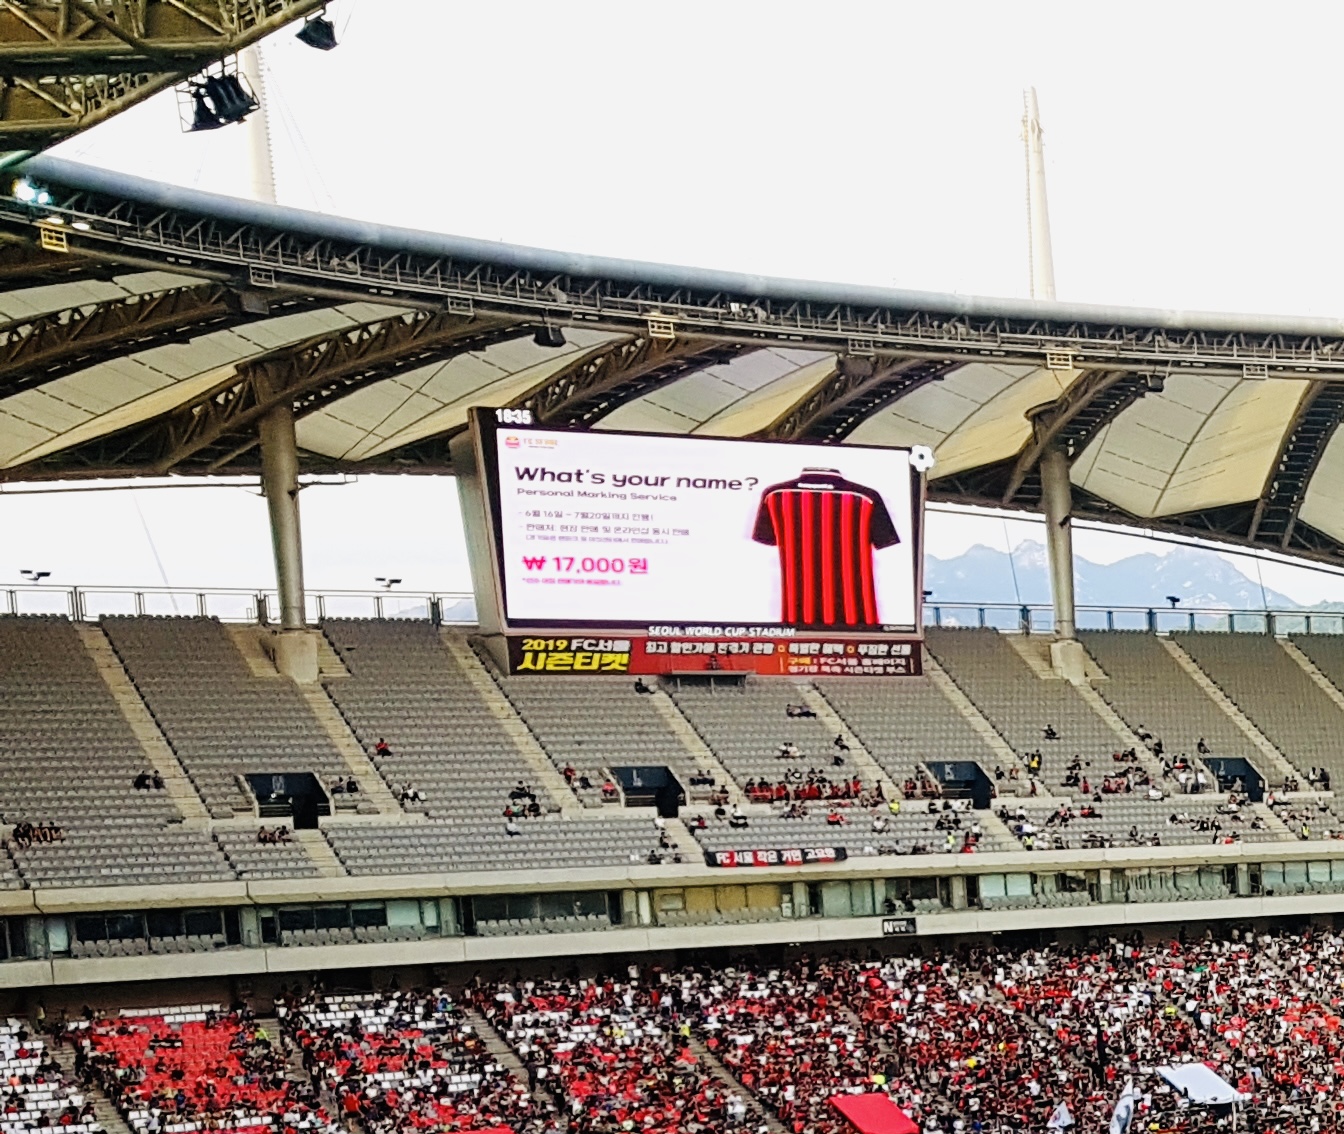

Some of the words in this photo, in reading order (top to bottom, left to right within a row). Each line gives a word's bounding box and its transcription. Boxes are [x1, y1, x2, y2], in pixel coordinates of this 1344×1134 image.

[515, 466, 605, 484] What's
[612, 474, 670, 487] your
[676, 477, 759, 491] name?
[517, 488, 574, 497] Personal
[577, 490, 627, 500] Marking
[630, 492, 677, 501] Service
[552, 557, 624, 573] 17,000
[628, 558, 649, 574] 원
[648, 626, 684, 635] SEOUL
[686, 627, 721, 636] WORLD
[725, 627, 745, 636] CUP
[749, 627, 796, 637] STADIUM
[522, 639, 567, 650] 2019
[517, 652, 629, 671] 시즌티켓
